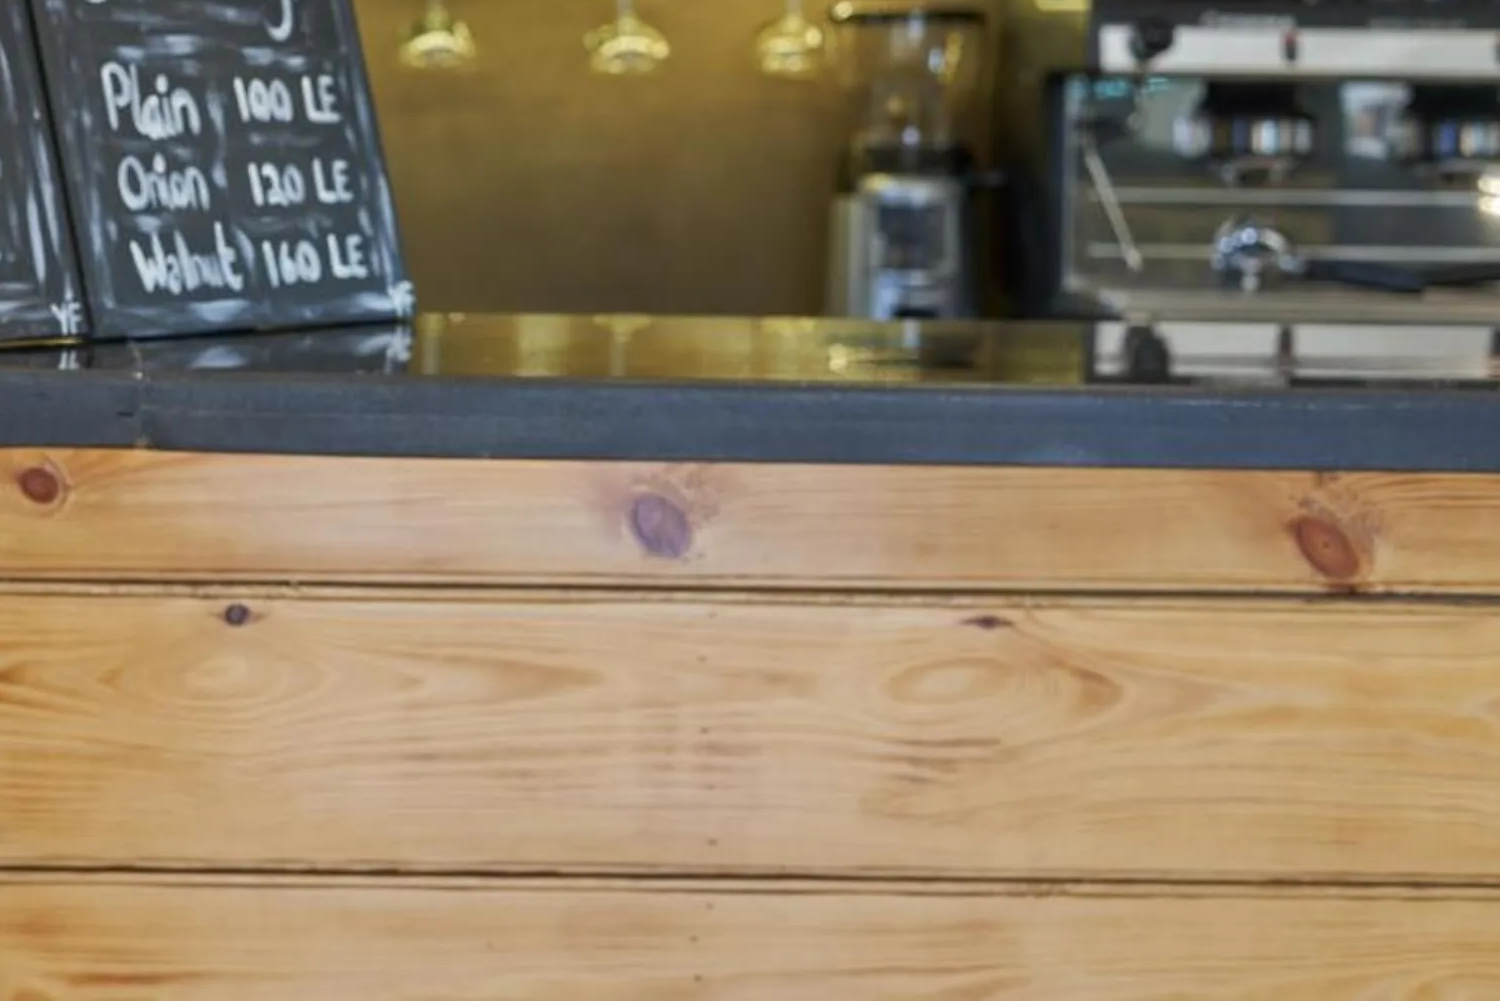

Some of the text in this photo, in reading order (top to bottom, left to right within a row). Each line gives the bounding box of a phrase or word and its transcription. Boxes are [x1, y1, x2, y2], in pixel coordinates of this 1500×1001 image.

[101, 61, 342, 141] Plain 100 LE
[248, 162, 305, 207] 120
[312, 157, 353, 203] LE
[129, 221, 368, 294] Walnut 160 LE
